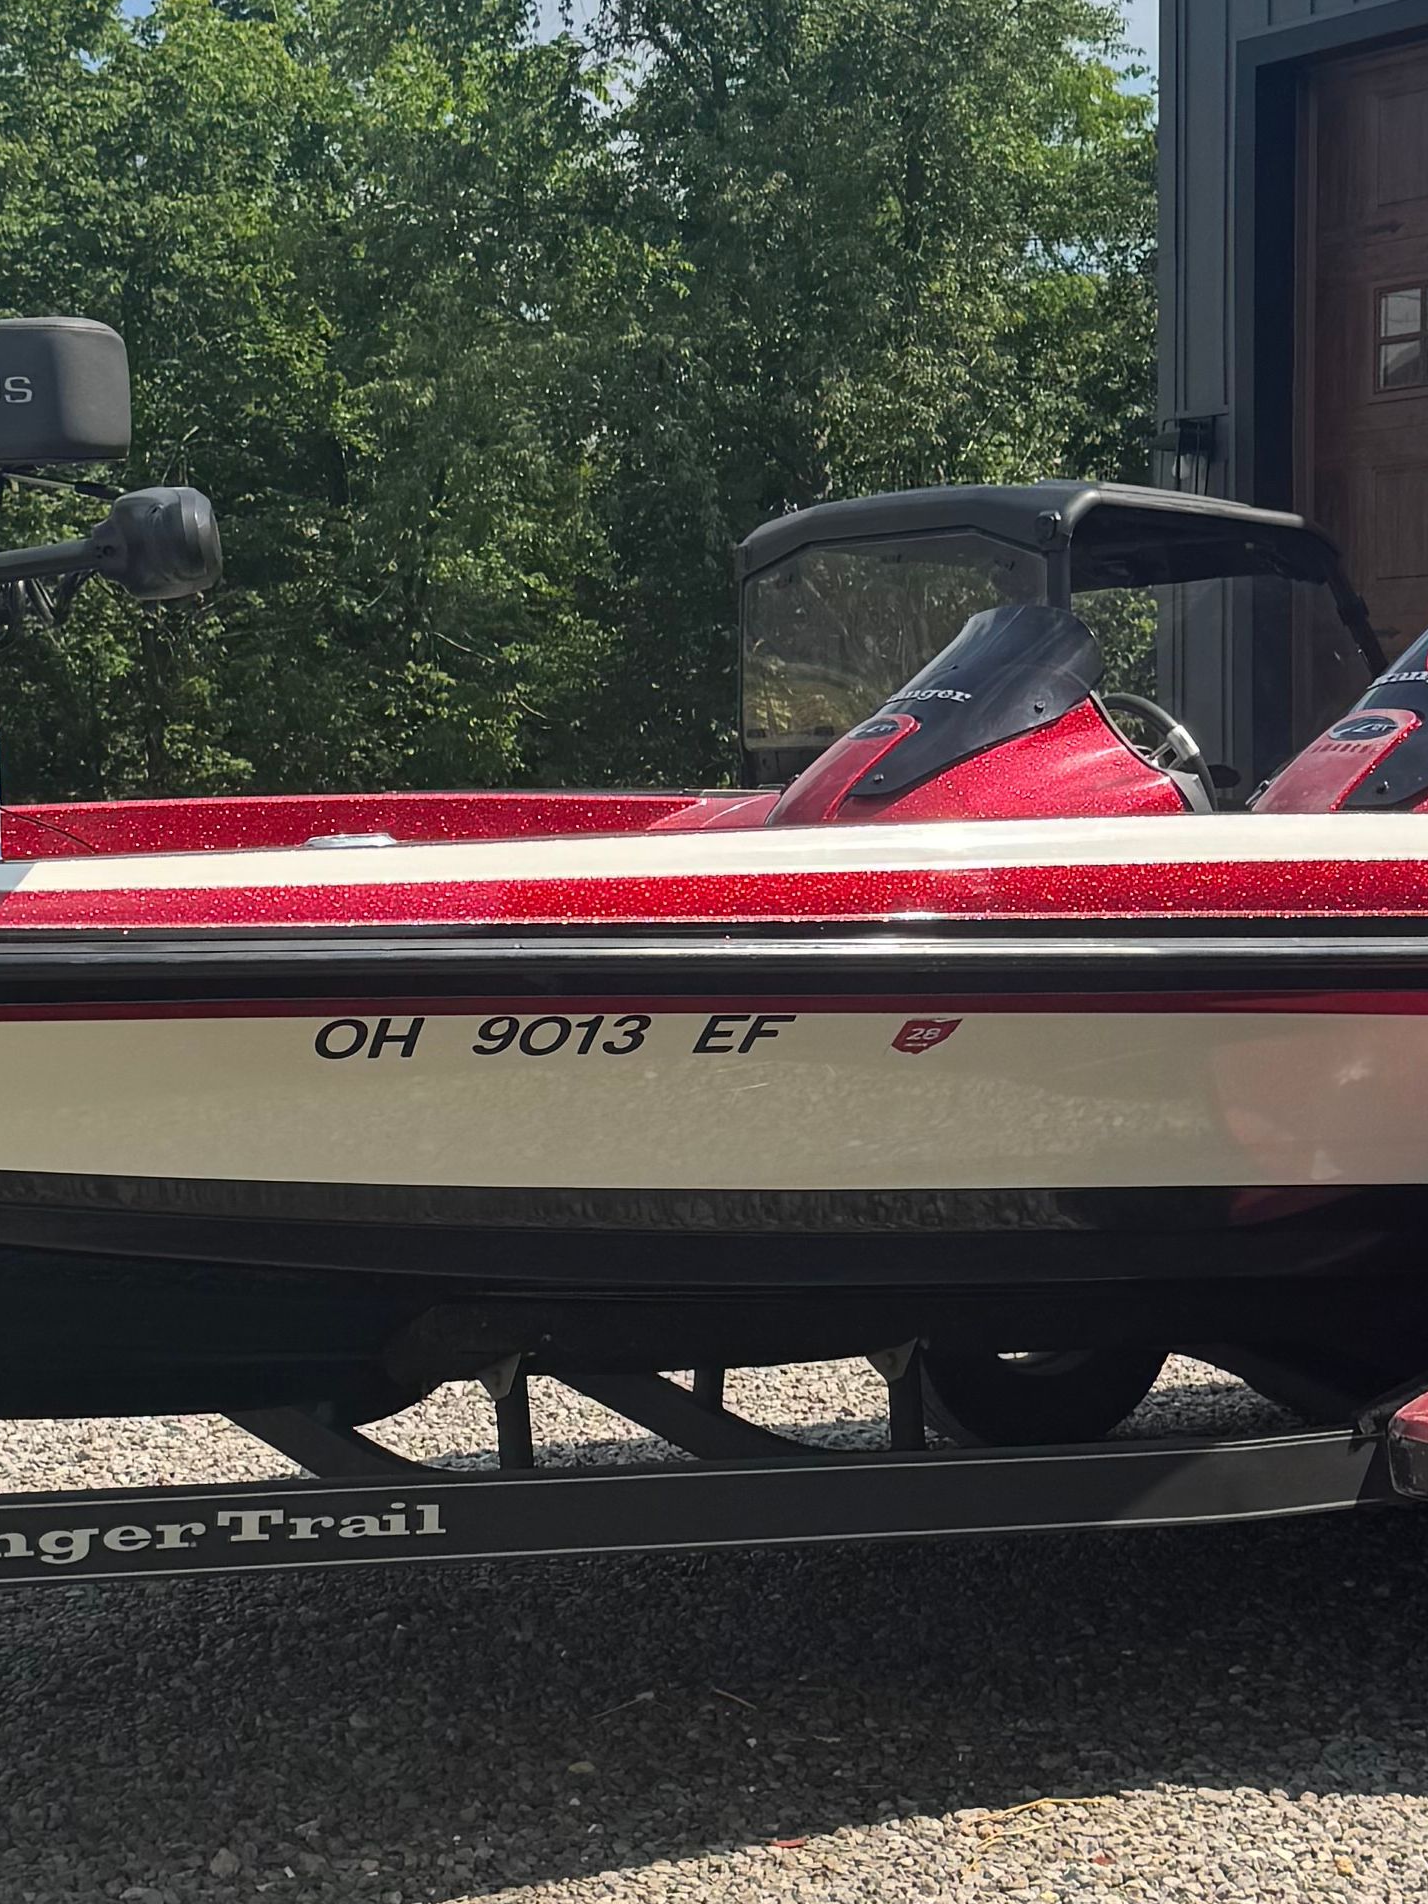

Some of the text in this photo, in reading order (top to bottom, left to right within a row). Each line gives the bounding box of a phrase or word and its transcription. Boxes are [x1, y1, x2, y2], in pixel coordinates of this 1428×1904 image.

[313, 1013, 798, 1060] OH 9013 EF
[905, 1027, 942, 1041] 28
[216, 1502, 447, 1543] Trail
